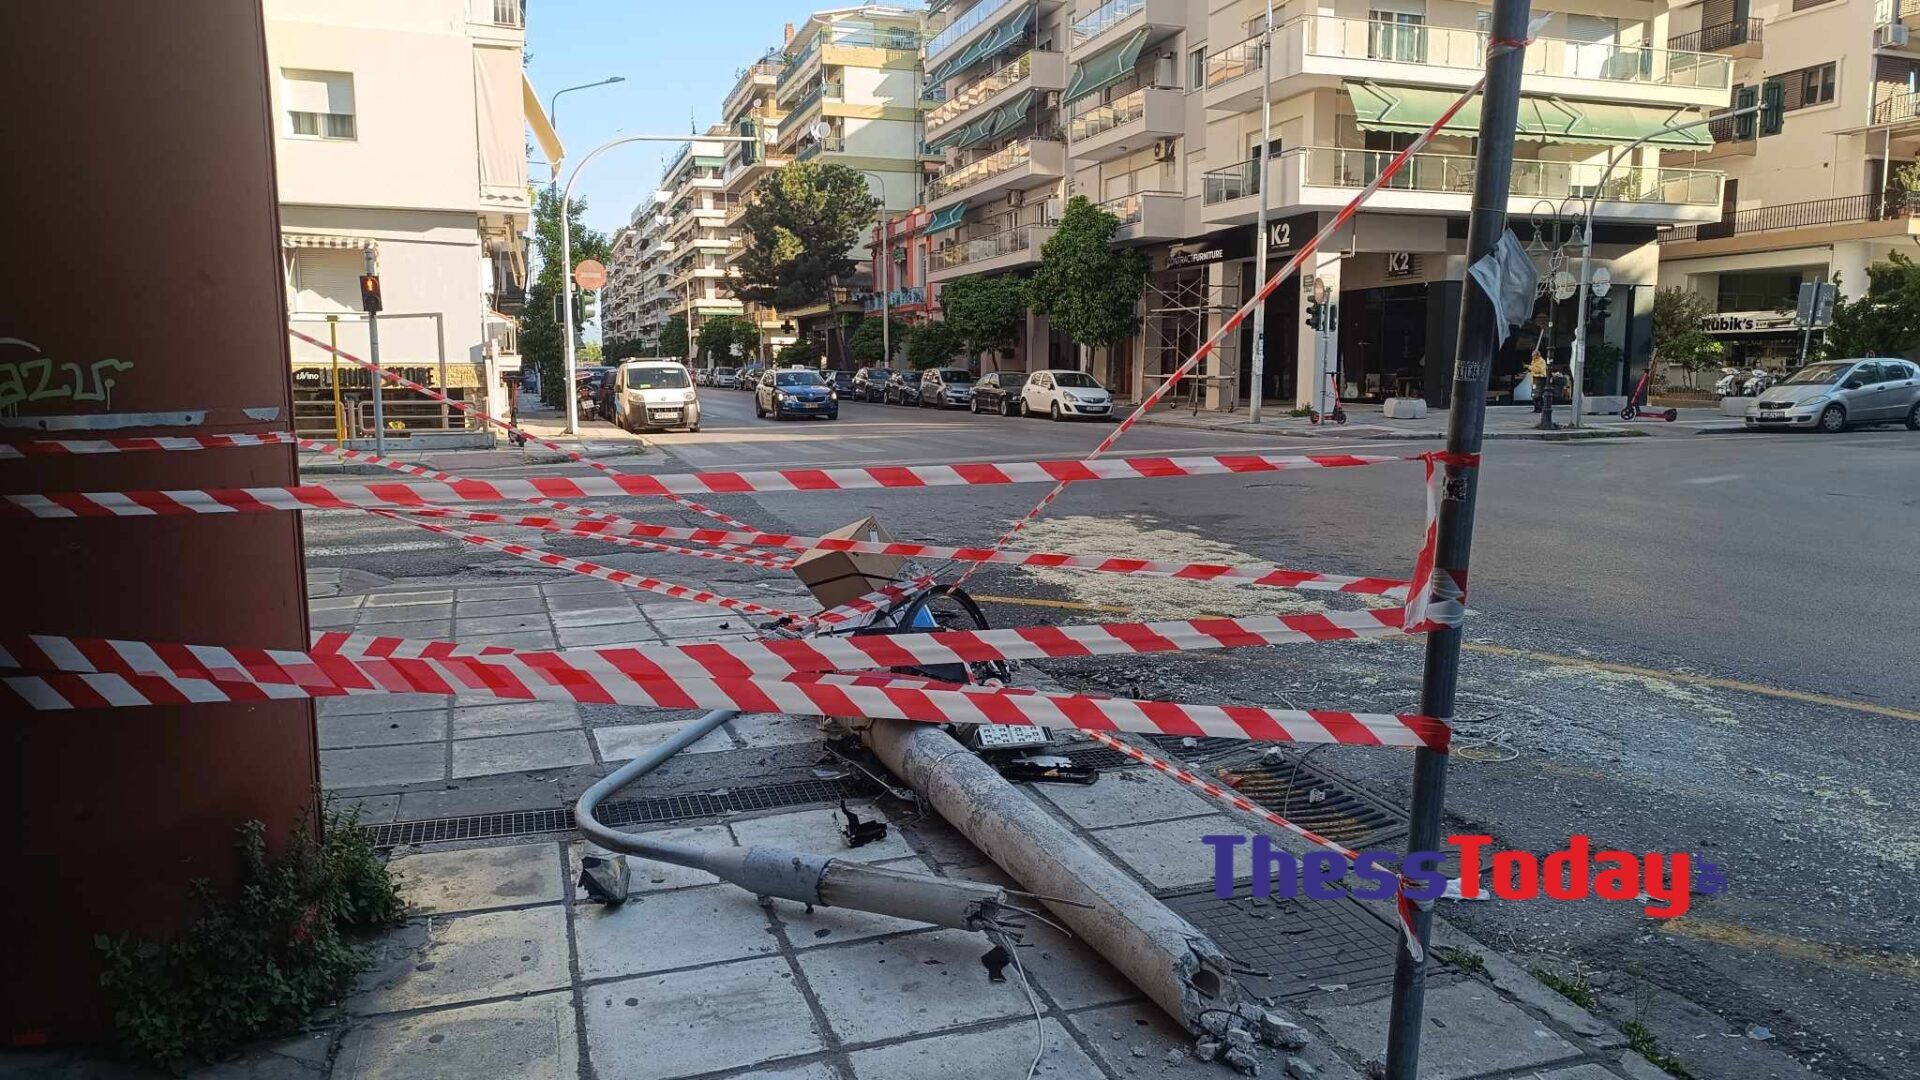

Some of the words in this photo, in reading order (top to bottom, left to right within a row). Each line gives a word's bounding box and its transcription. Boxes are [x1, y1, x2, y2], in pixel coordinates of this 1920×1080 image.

[1271, 223, 1290, 245] K2
[1193, 249, 1224, 262] FURNITURE
[1389, 252, 1409, 271] K2
[1700, 315, 1753, 331] Rubik's
